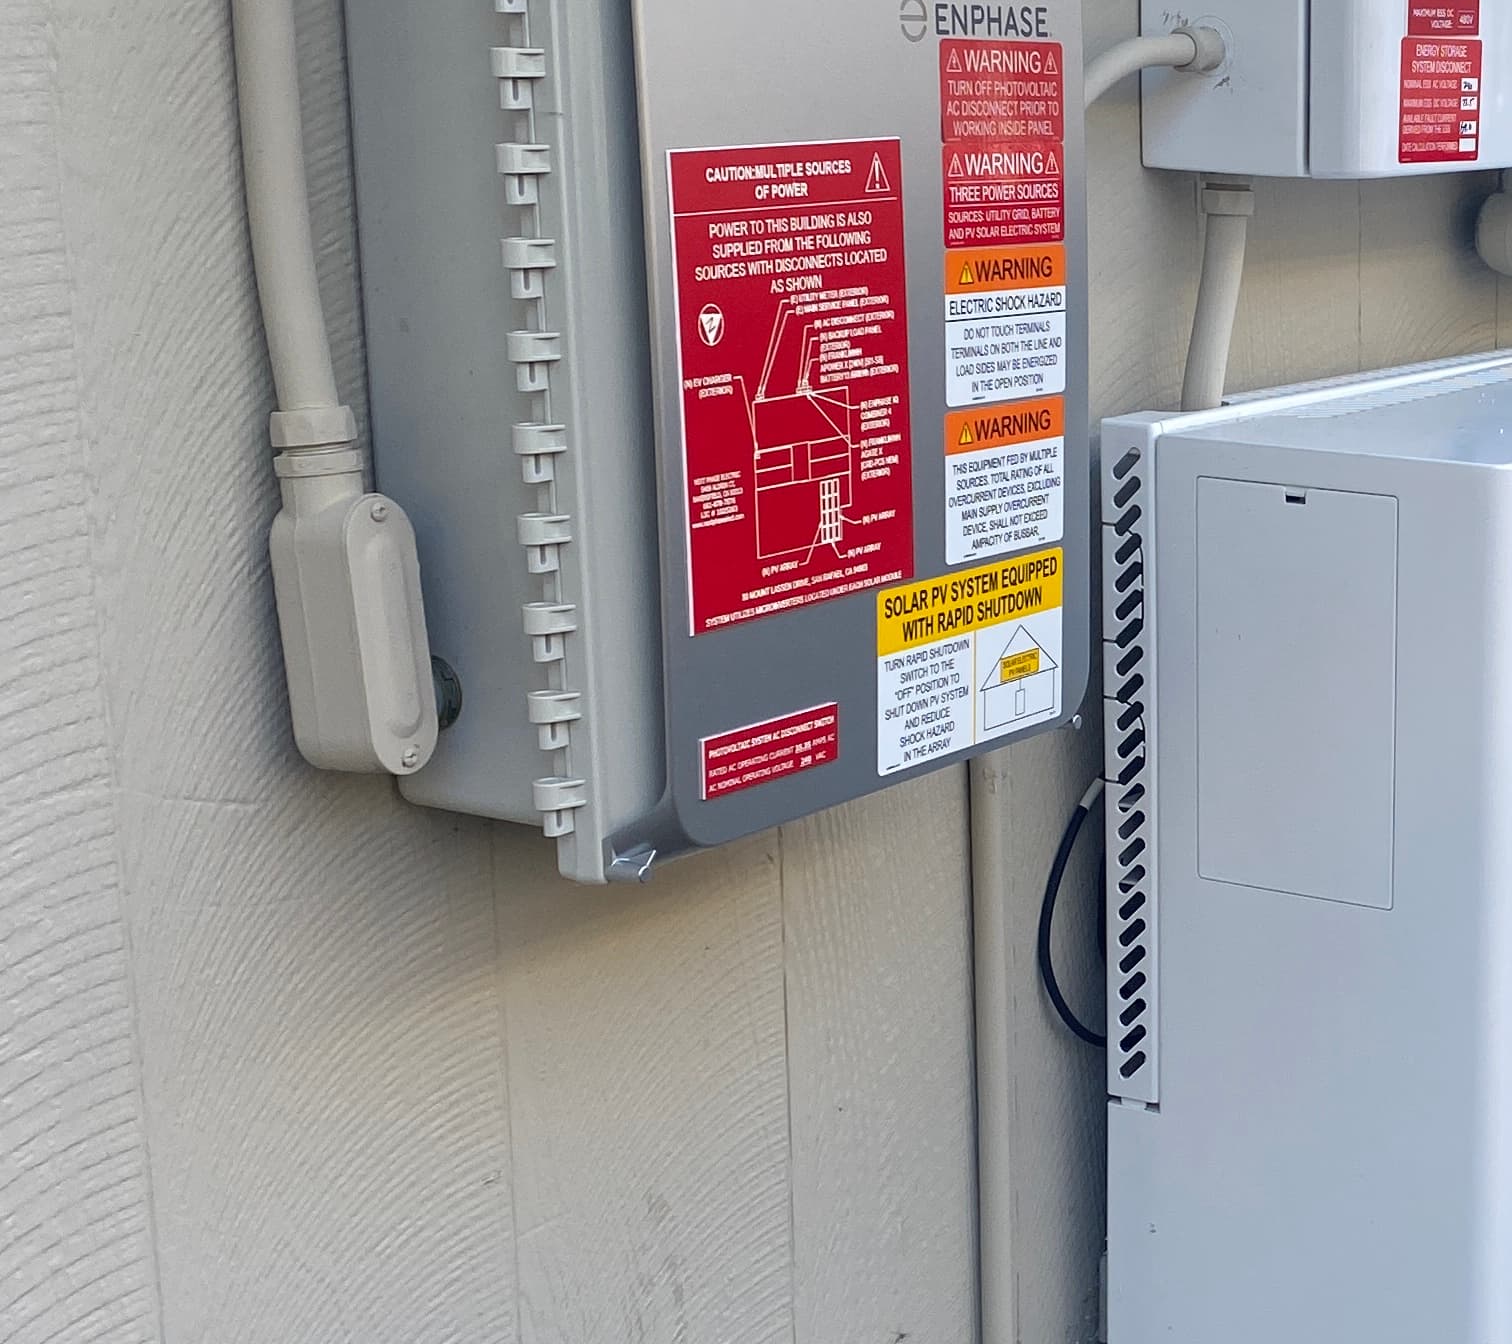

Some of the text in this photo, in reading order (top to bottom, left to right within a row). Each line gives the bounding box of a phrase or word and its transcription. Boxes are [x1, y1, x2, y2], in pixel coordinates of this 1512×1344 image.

[935, 4, 1048, 37] ENPHASE
[964, 50, 1041, 74] WARNING
[1416, 45, 1467, 57] ENERGY STORAGE
[1412, 61, 1471, 74] SYSTEM DISCONNECT
[948, 80, 1057, 97] TURN OFF PHOTOVOLTAIC
[947, 101, 1059, 116] AC DISCONNECT PRIOR TO
[953, 120, 1054, 136] WORKING INSIDE PANEL
[806, 160, 851, 177] SOURCES
[965, 152, 1042, 176] WARNING
[755, 183, 808, 199] OF POWER
[950, 183, 1058, 203] THREE POWER SOURCES
[709, 211, 872, 238] POWER TO THIS BUILDING IS ALSO
[948, 207, 1060, 223] SOURCES: UTILITY GRID, BATTERY
[949, 223, 1060, 240] AND PV SOLAR ELECTRIC SYSTEM
[713, 231, 871, 258] SUPPLIED FROM THE FOLLOWING
[695, 248, 887, 281] SOURCES WITH DISCONNECTS LOCATED
[975, 256, 1052, 282] WARNING
[771, 275, 822, 293] AS SHOWN
[950, 292, 1062, 315] ELECTRIC SHOCK HAZARD
[964, 321, 1050, 340] DO NOT TOUCH TERMINALS
[951, 337, 1062, 359] TERMINALS ON BOTH THE LINE AND
[956, 355, 1057, 376] LOAD SIDES MAY BE ENERGIZED
[972, 374, 1043, 393] IN THE OPEN POSITION
[975, 409, 1051, 441] WARNING
[953, 447, 1057, 476] THIS EQUIPMENT FED BY MULTIPLE
[991, 471, 1009, 484] TOTAL
[1011, 467, 1033, 481] RATING
[1035, 466, 1042, 477] OF
[1043, 464, 1054, 475] ALL
[949, 489, 996, 508] OVERCURRENT
[1027, 477, 1061, 493] EXCLUDING
[962, 494, 1049, 521] MAIN SUPPLY OVERCURRENT
[990, 517, 1008, 531] SHALL
[1010, 514, 1023, 527] NOT
[1024, 510, 1048, 524] EXCEED
[972, 533, 1002, 550] AMPACITY
[1004, 531, 1013, 543] OF
[885, 557, 1056, 618] SOLAR PV SYSTEM EQUIPPED
[902, 586, 1042, 642] WITH RAPID SHUTDOWN
[885, 640, 969, 672] TURN RAPID SHUTDOWN
[900, 659, 954, 684] SWITCH TO THE
[916, 676, 948, 695] POSITION
[950, 673, 960, 686] TO
[885, 686, 969, 720] SHUT DOWN PV SYSTEM
[905, 707, 950, 730] AND REDUCE
[900, 722, 954, 747] SHOCK HAZARD
[904, 738, 951, 762] IN THE ARRAY
